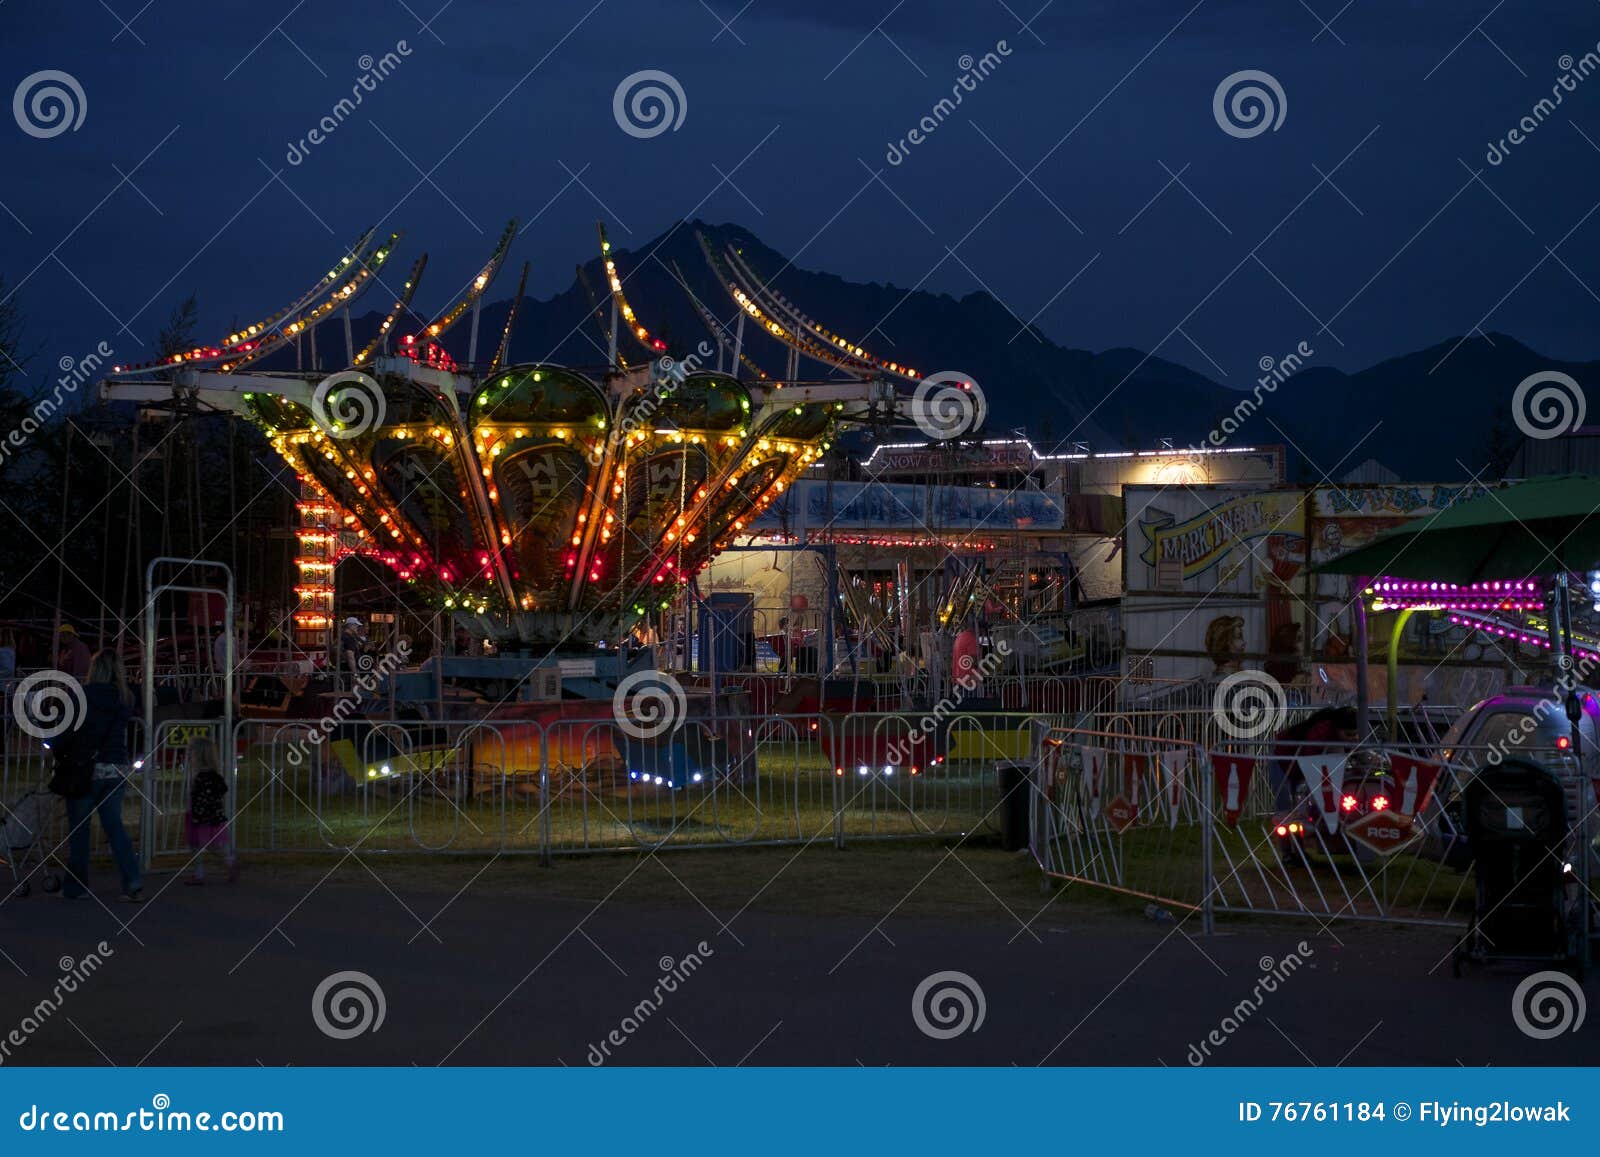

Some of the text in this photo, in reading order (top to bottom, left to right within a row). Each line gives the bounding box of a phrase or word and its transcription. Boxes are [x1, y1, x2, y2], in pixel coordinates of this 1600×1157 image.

[1162, 501, 1264, 565] MARK TWAIN
[1366, 826, 1401, 840] RCS
